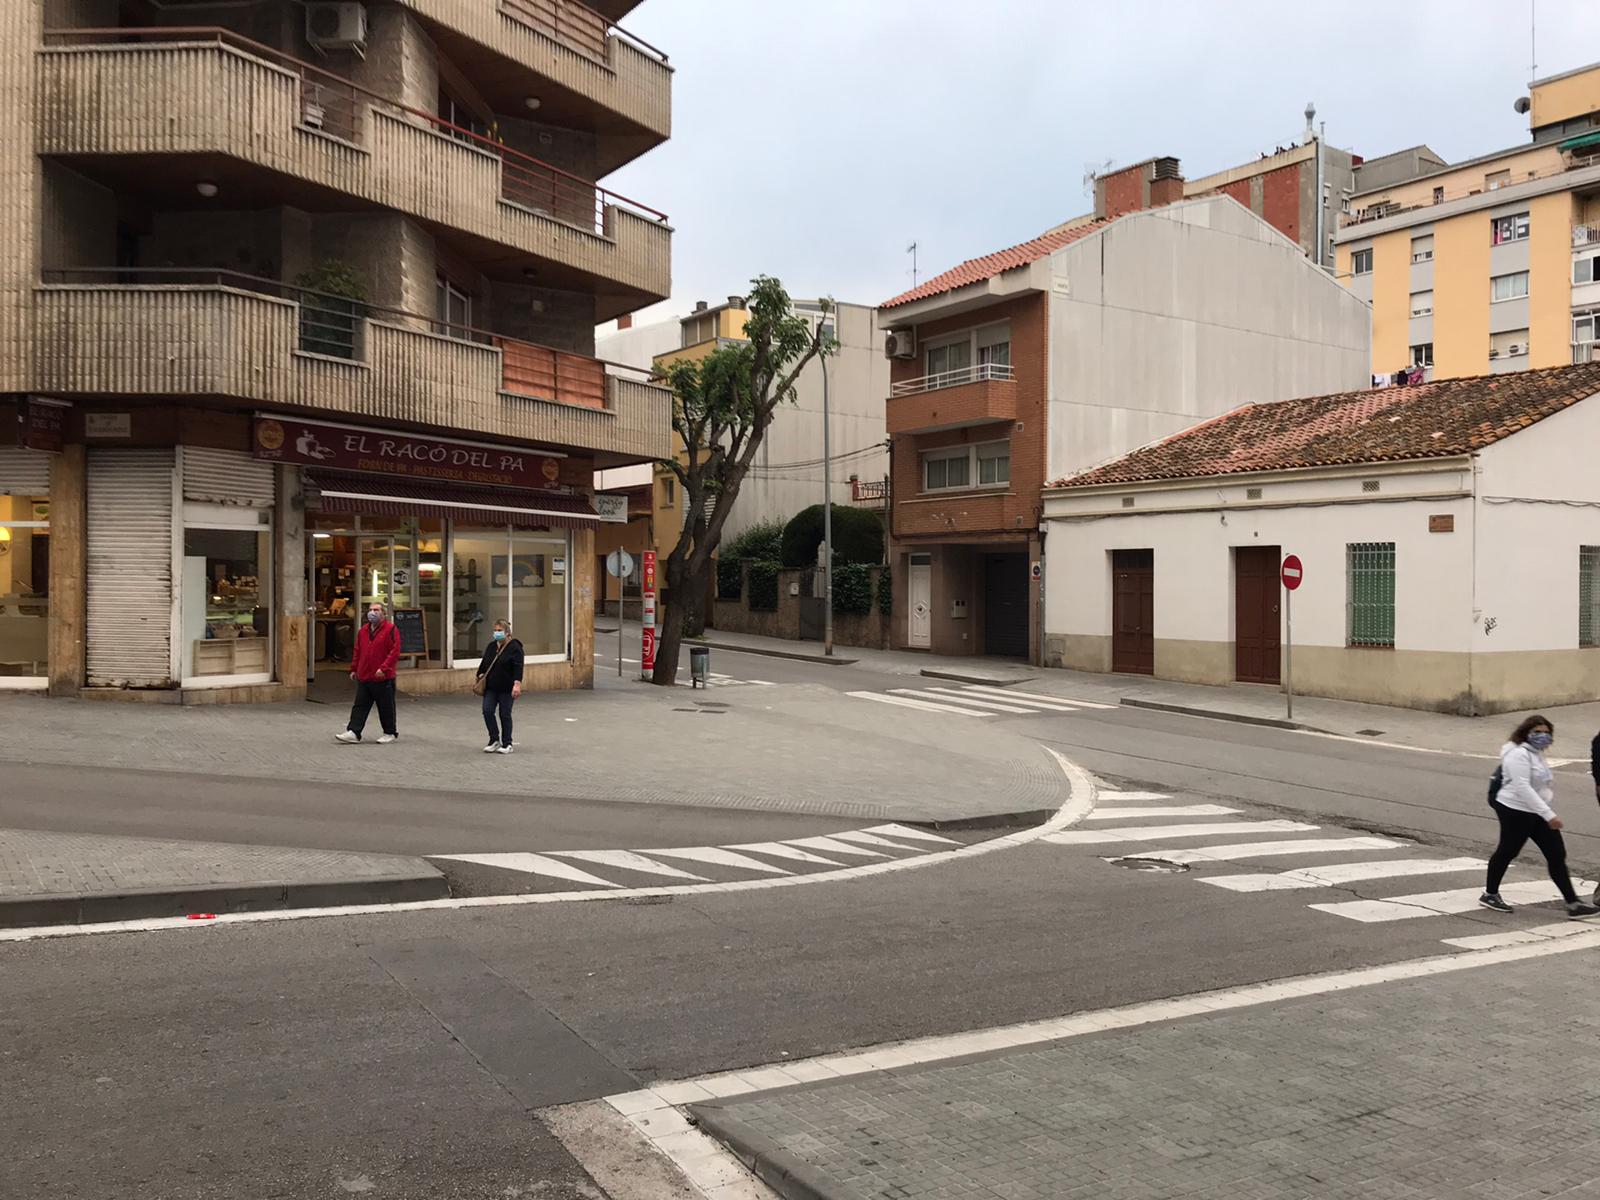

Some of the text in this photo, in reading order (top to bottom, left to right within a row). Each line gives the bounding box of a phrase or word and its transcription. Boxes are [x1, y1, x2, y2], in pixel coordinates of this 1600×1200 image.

[344, 434, 371, 453] EL
[379, 440, 447, 462] RACÓ
[451, 450, 493, 468] DEL
[500, 455, 525, 472] PA
